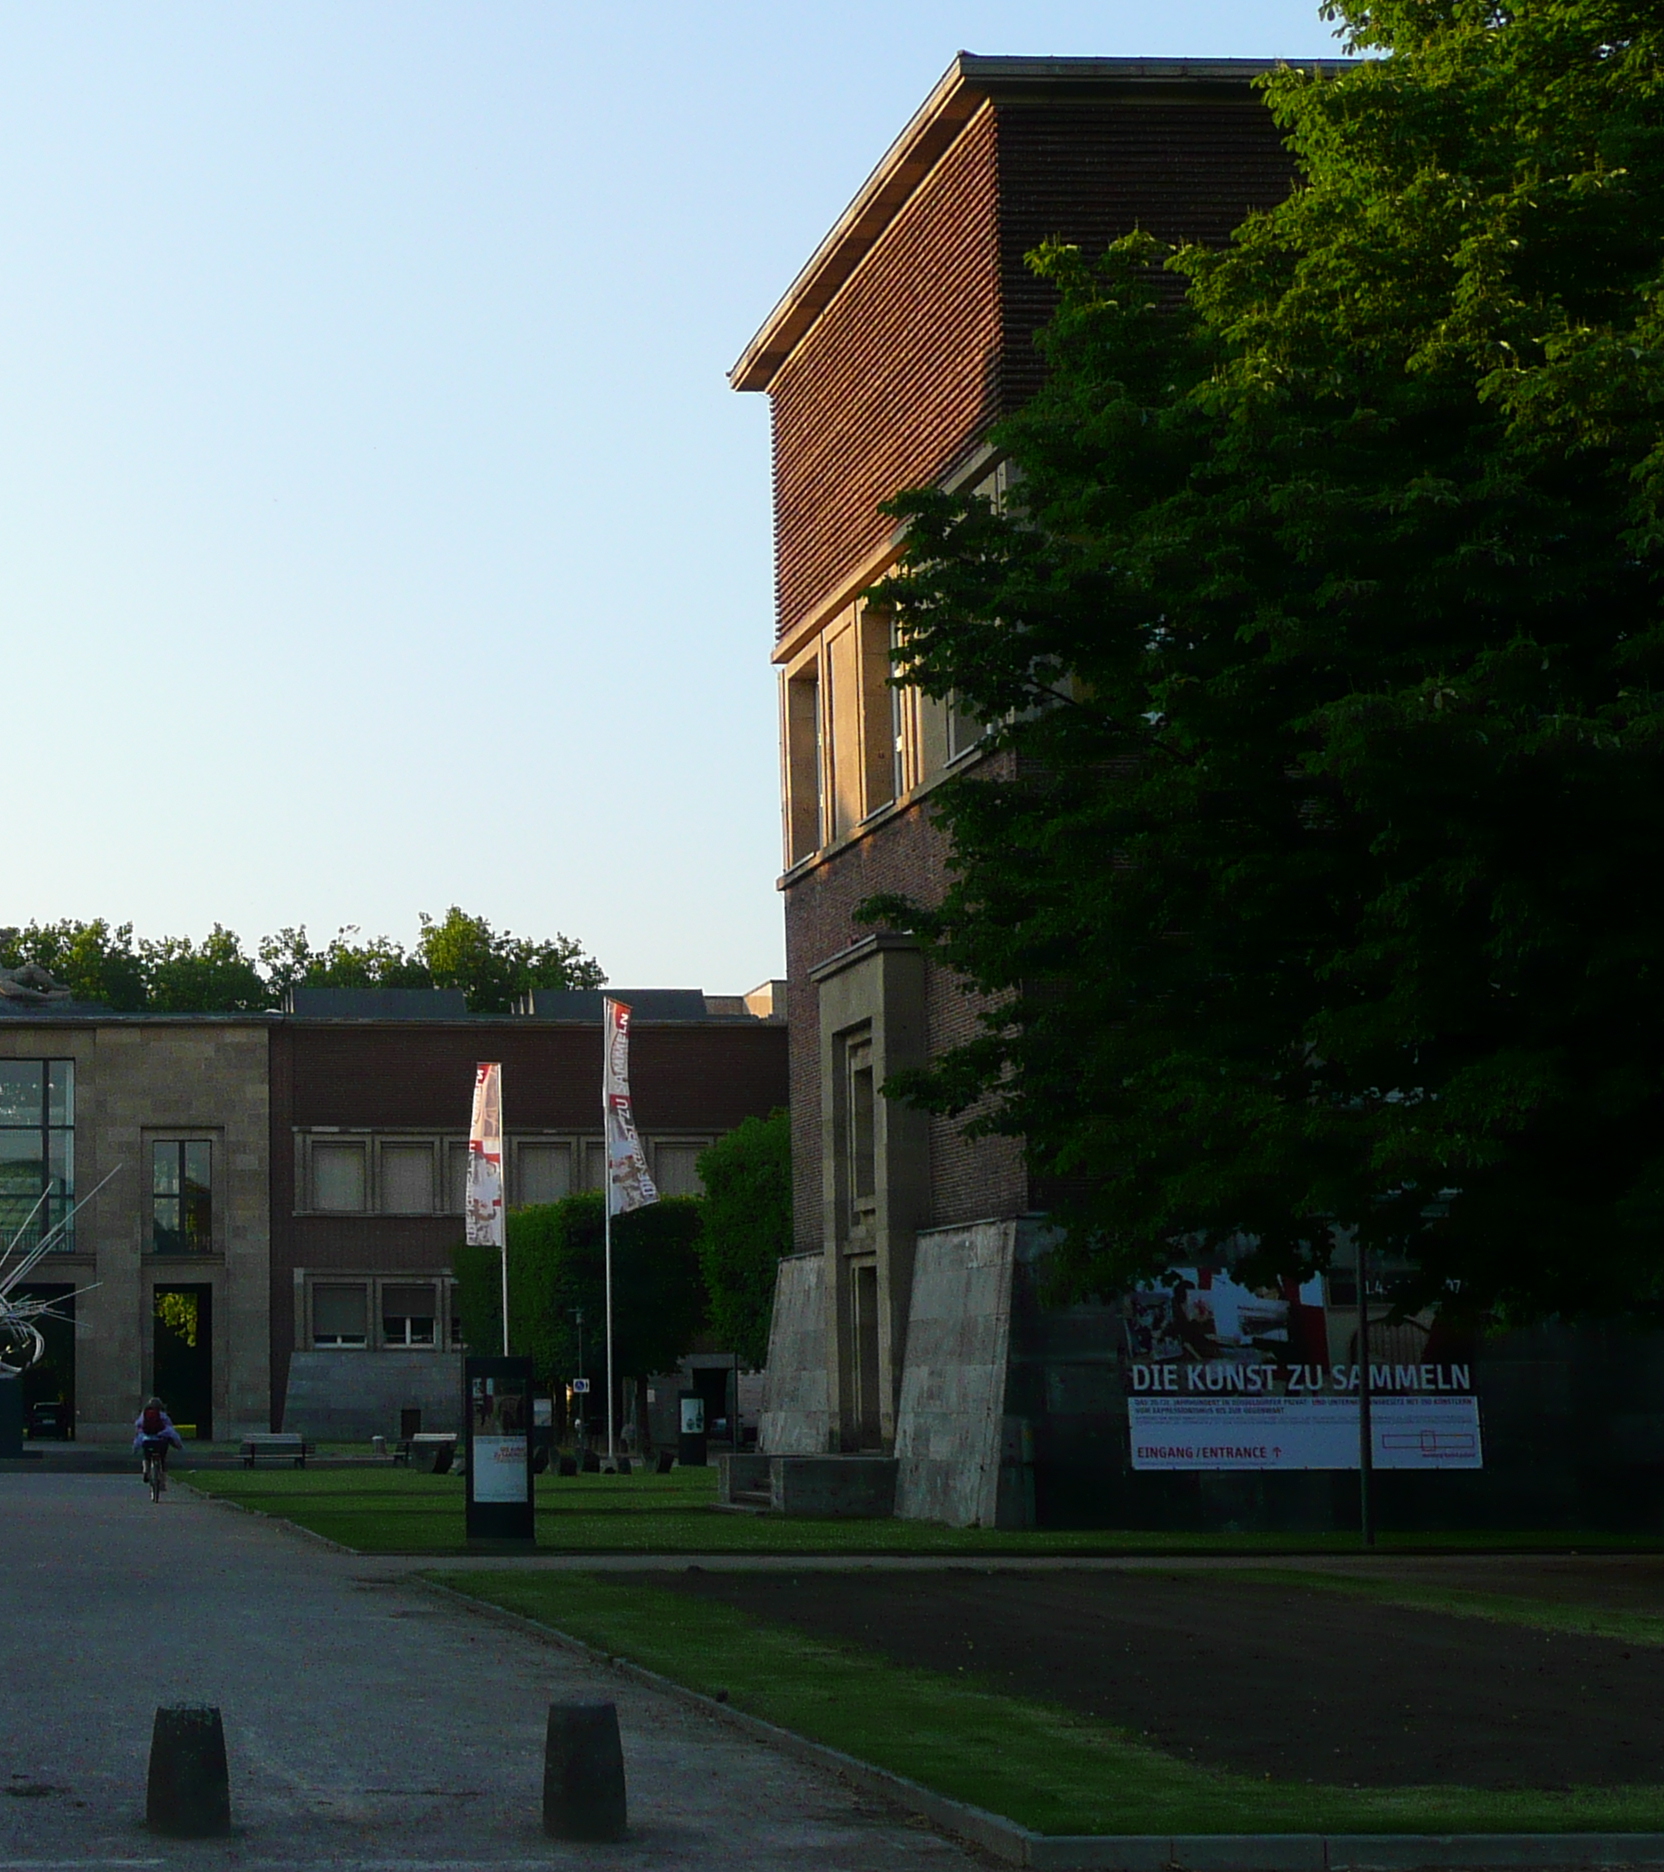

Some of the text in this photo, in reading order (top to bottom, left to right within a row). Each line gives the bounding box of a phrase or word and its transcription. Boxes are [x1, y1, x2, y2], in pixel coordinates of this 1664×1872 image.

[1132, 1364, 1471, 1391] DIE KUNST ZU SAMMELN
[1137, 1447, 1193, 1459] EINGANG
[1202, 1447, 1267, 1459] ENTRANCE
